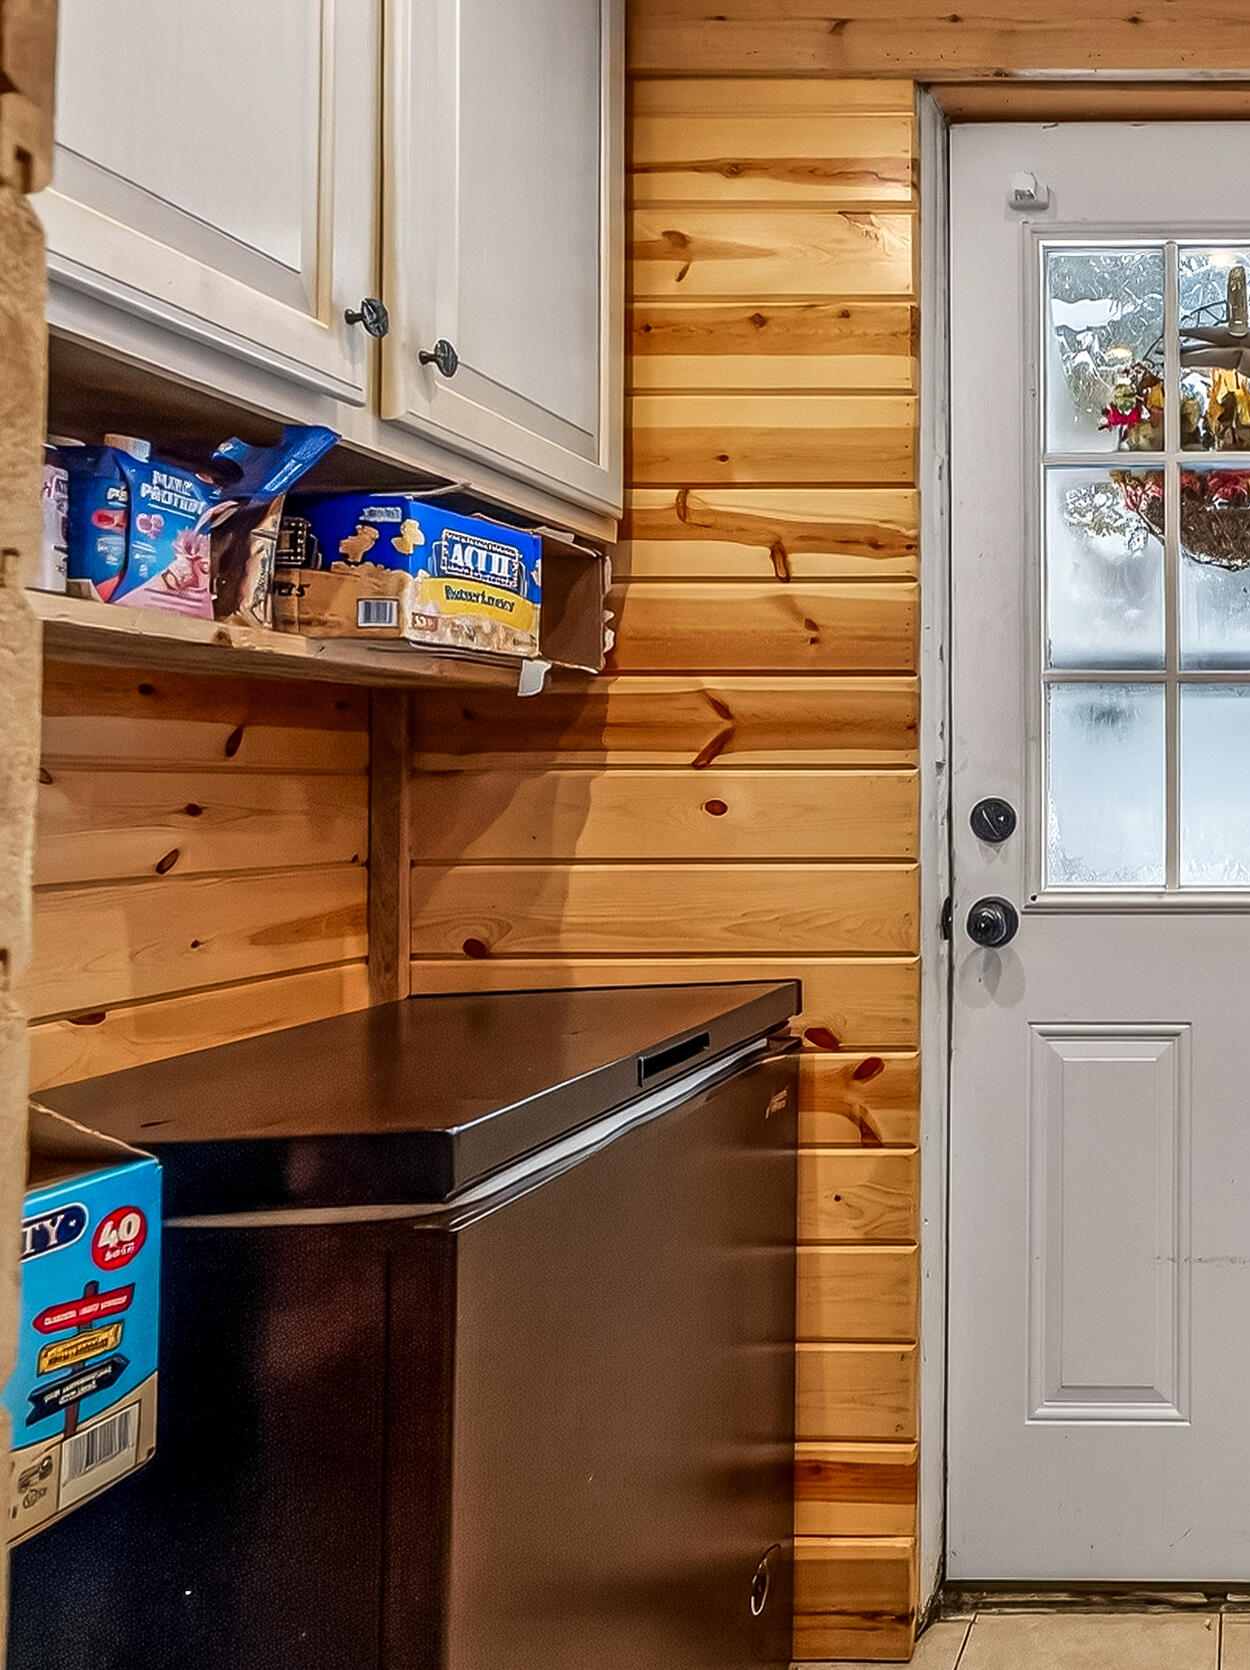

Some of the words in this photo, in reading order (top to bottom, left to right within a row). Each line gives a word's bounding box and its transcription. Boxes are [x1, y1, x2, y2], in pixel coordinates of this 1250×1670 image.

[450, 543, 489, 572] ACT
[20, 1214, 65, 1255] TY
[98, 1213, 141, 1249] 40
